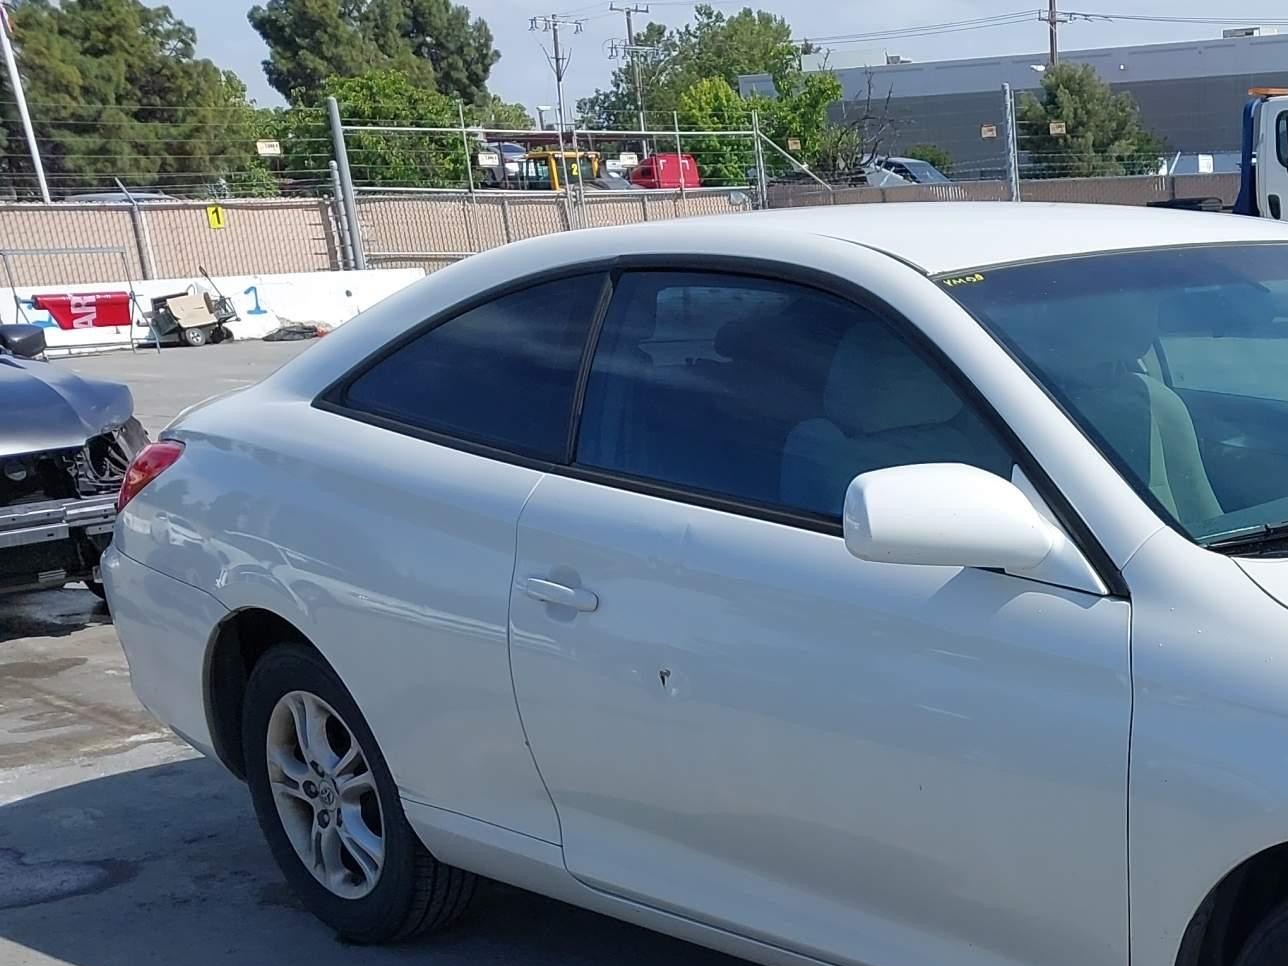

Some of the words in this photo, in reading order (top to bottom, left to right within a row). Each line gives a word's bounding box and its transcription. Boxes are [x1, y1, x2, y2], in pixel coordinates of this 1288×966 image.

[571, 163, 578, 175] 2
[212, 207, 221, 225] 1
[244, 286, 268, 314] 1
